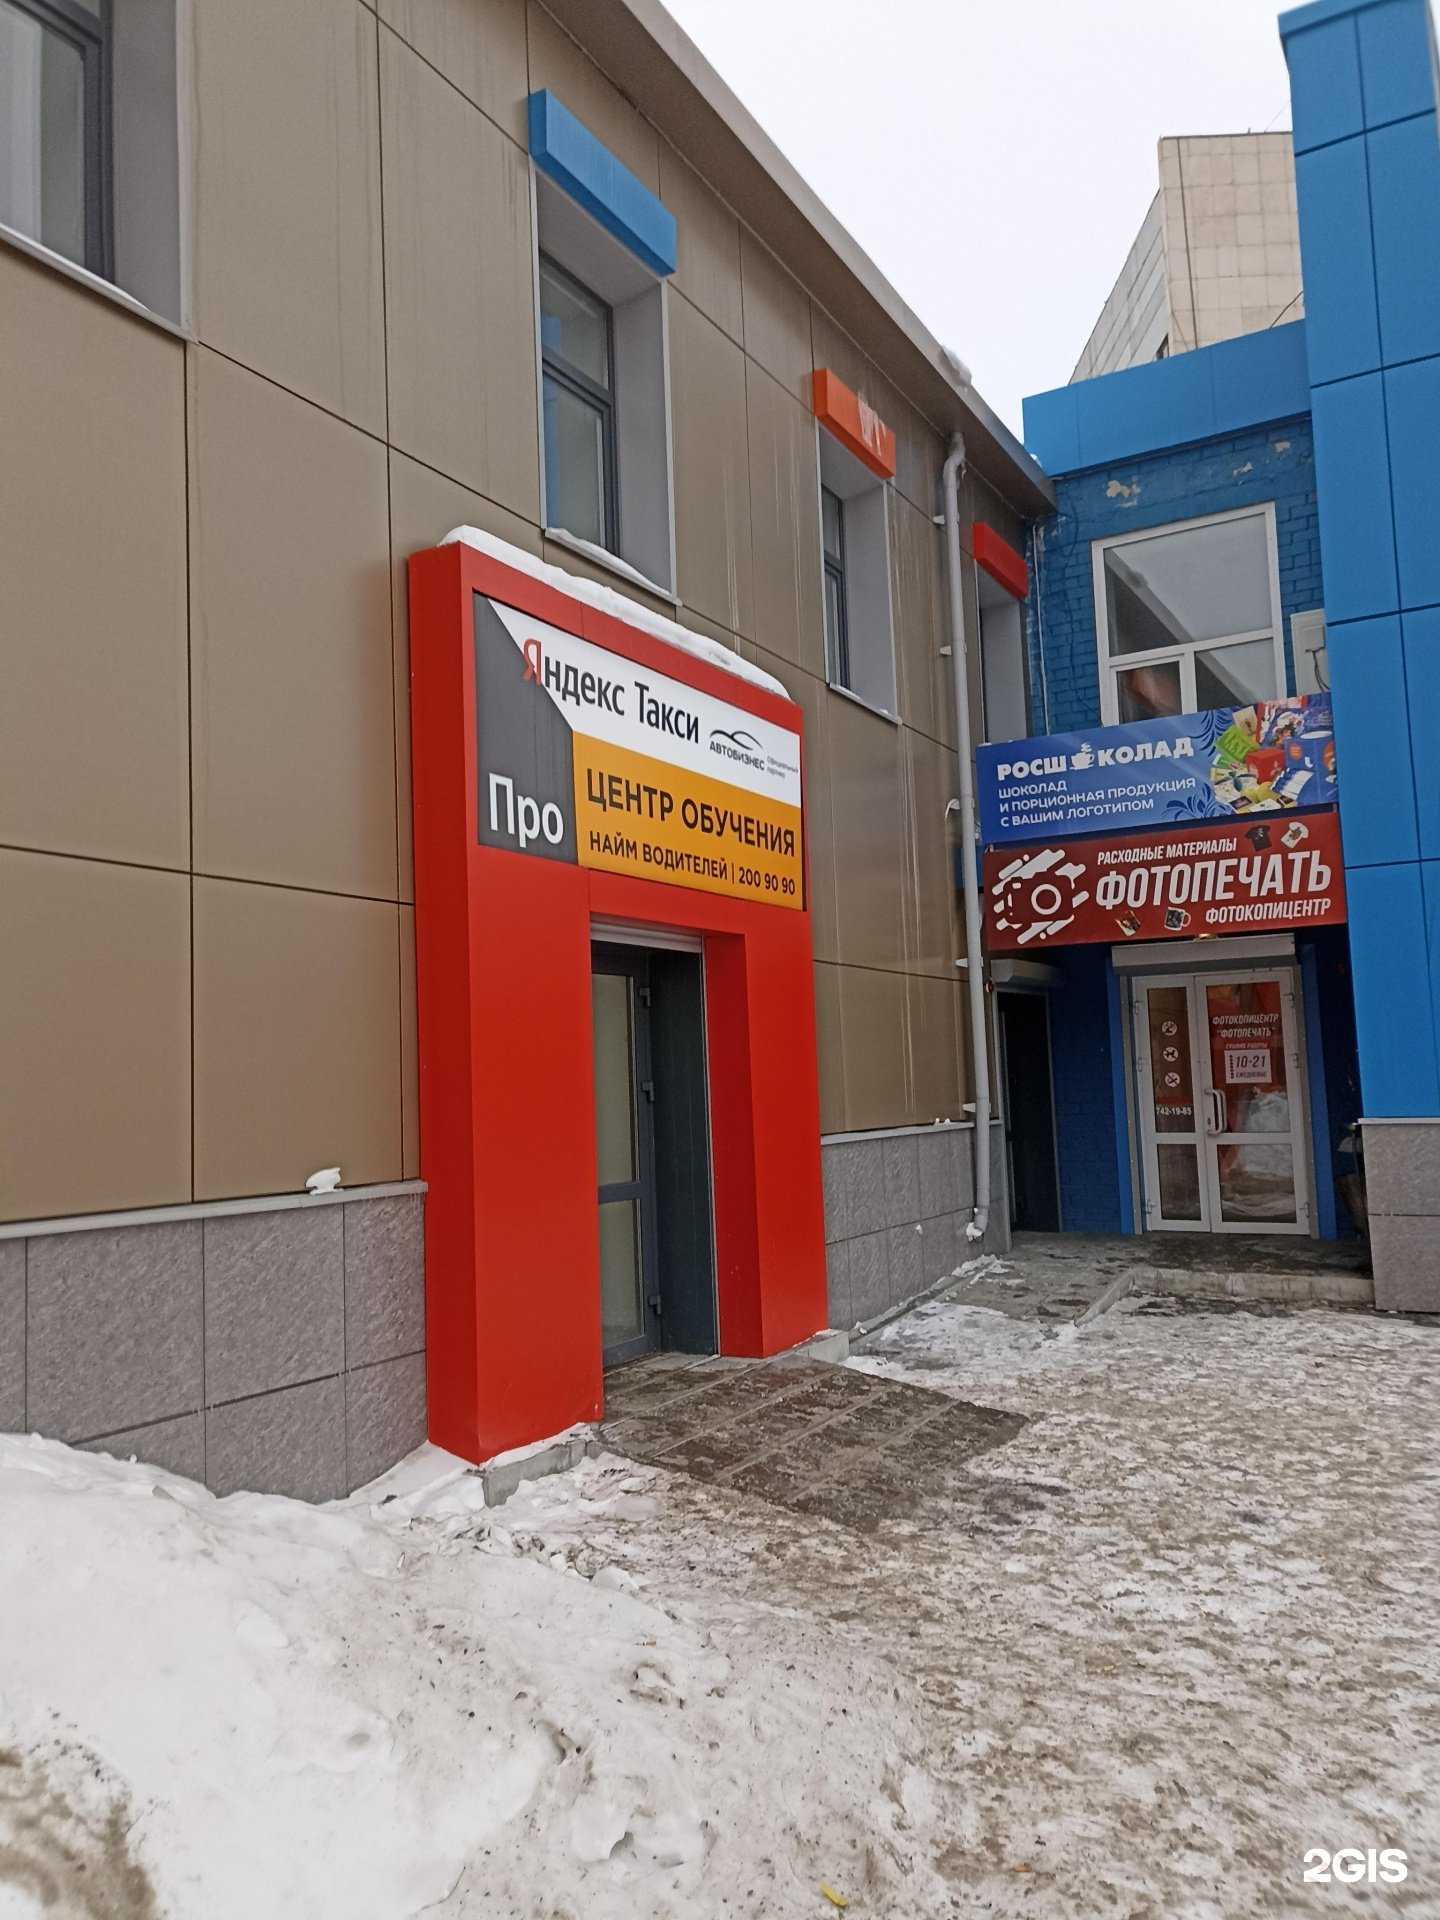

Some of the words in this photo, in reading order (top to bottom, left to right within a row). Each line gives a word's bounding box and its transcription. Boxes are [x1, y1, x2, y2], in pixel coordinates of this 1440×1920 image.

[523, 638, 625, 716] Яндекс
[634, 680, 700, 744] Такси
[709, 741, 765, 771] АВТОБИЗНЕС
[1098, 736, 1195, 767] КОЛАД
[998, 780, 1068, 799] ШОКОЛАД
[1000, 803, 1009, 813] И
[1012, 791, 1105, 812] ПОРЦИОННАЯ
[1107, 777, 1197, 799] ПРОДУКЦИЯ
[488, 772, 564, 848] Про
[587, 768, 674, 823] ЦЕНТР
[681, 798, 796, 857] ОБУЧЕНИЯ
[1000, 816, 1010, 827] С
[1012, 810, 1064, 827] ВАШИМ
[1066, 799, 1154, 820] ЛОГОТИПОМ
[590, 830, 638, 860] НАЙМ
[643, 843, 728, 881] ВОДИТЕЛЕЙ
[738, 866, 761, 888] 200
[765, 873, 779, 892] 90
[782, 878, 796, 896] 90
[1097, 845, 1164, 866] РАСХОДНЫЕ
[1166, 837, 1238, 858] МАТЕРИАЛЫ
[1095, 849, 1332, 911] ФОТОПЕЧАТЬ
[1206, 898, 1332, 925] ФОТОКОПИЦЕНТР
